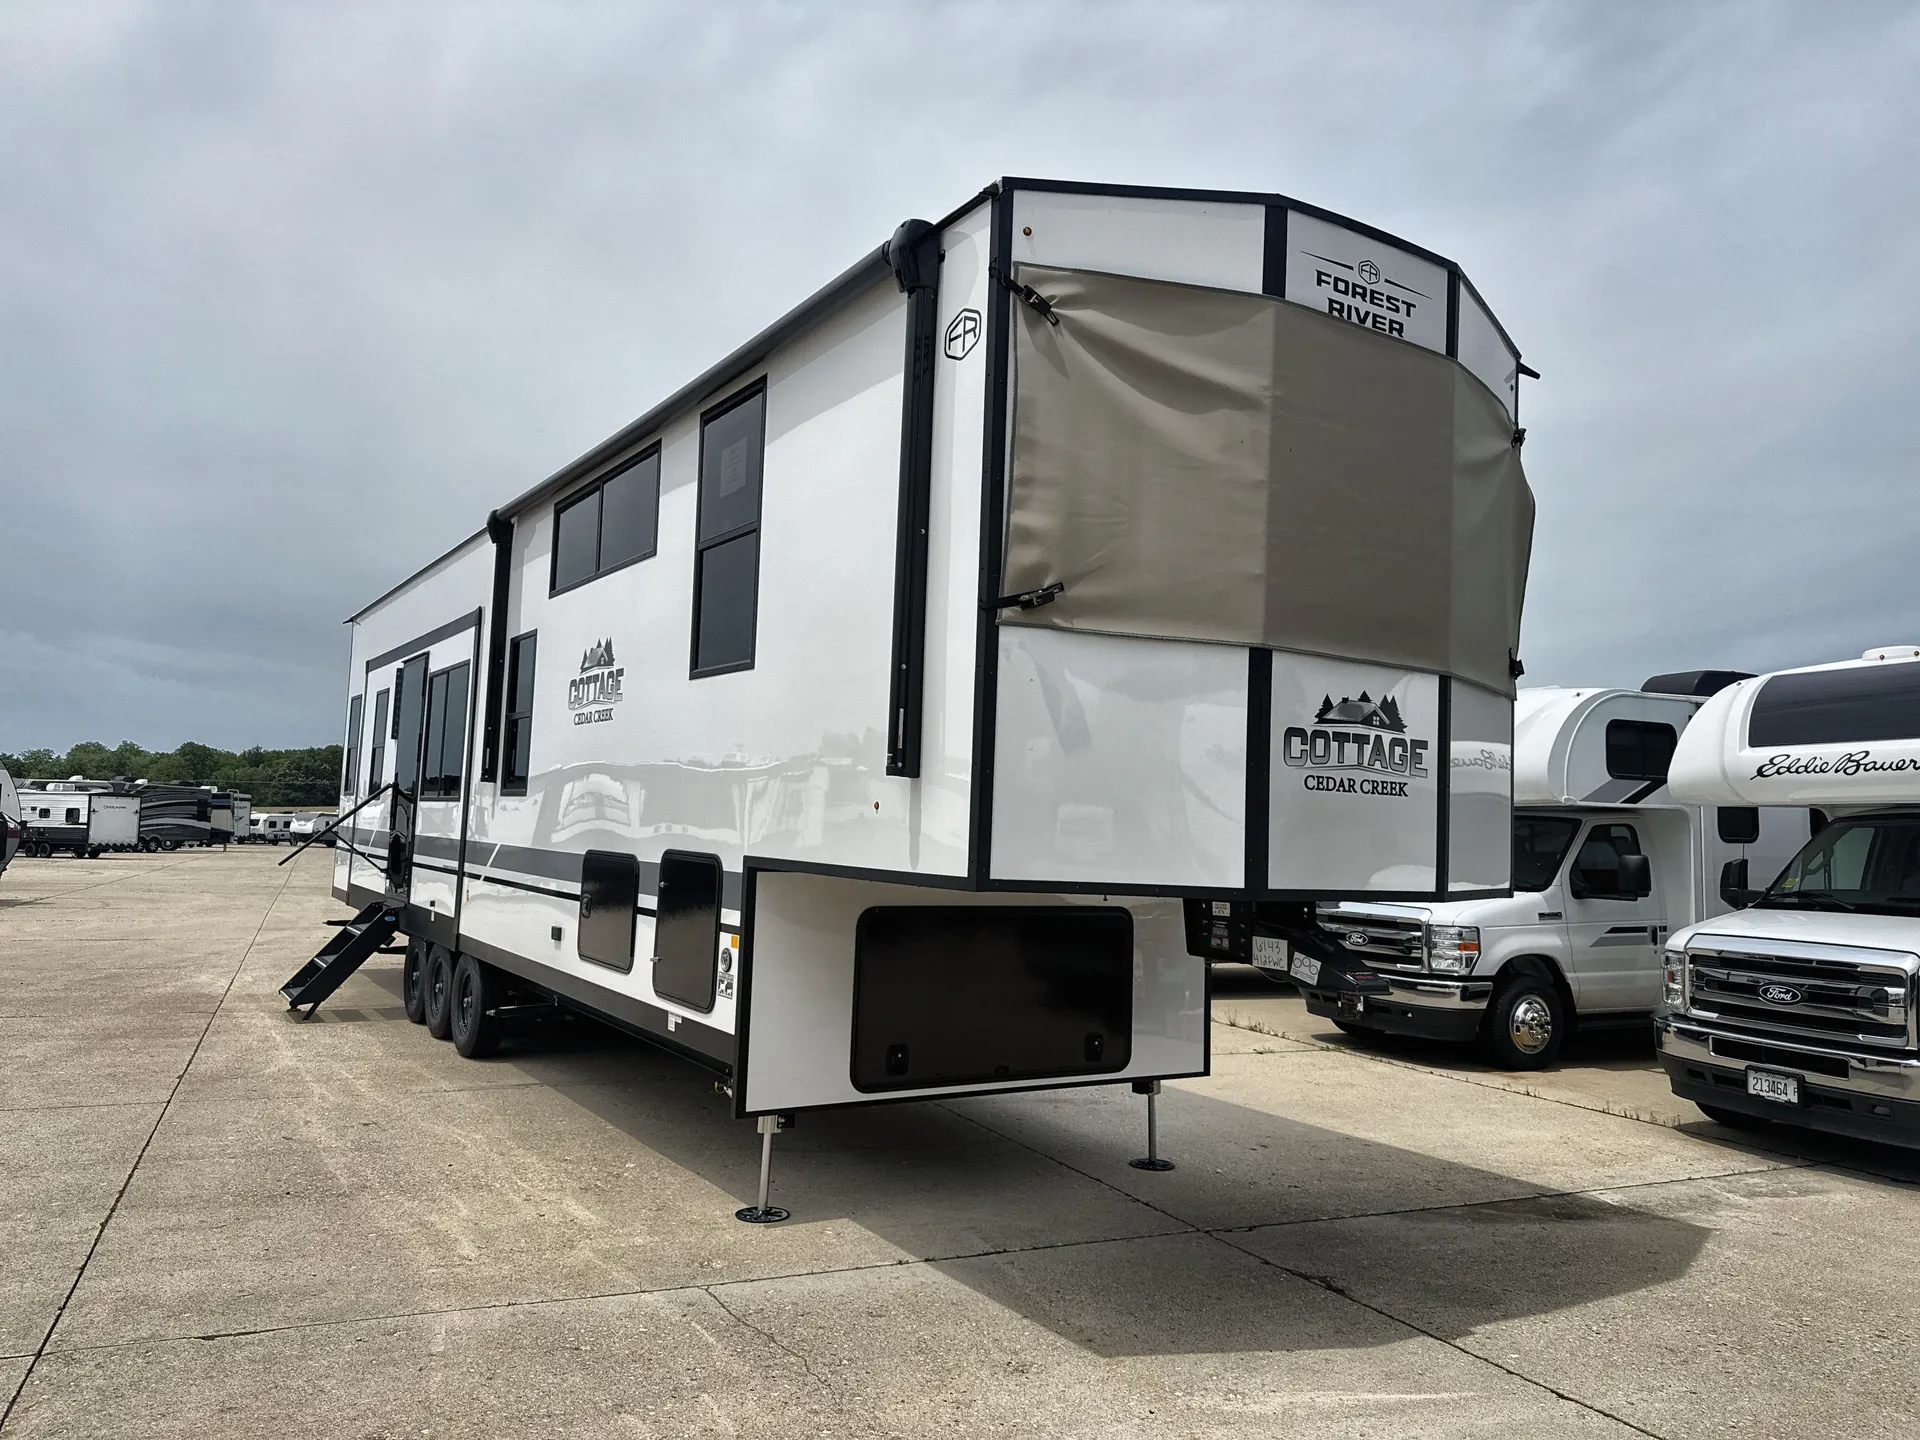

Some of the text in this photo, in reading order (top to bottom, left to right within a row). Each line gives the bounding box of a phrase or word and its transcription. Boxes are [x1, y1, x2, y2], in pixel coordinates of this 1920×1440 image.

[1315, 269, 1416, 317] FOREST
[1327, 297, 1404, 338] RIVER
[567, 667, 624, 710] COTTAGE
[573, 708, 613, 725] CEDAR CREEK
[1283, 726, 1428, 778] COTTAGE
[1750, 750, 1920, 780] Eddie Bauer
[1304, 775, 1408, 797] CEDAR CREEK
[1766, 987, 1793, 1000] Ford
[1752, 1076, 1788, 1097] 213464
